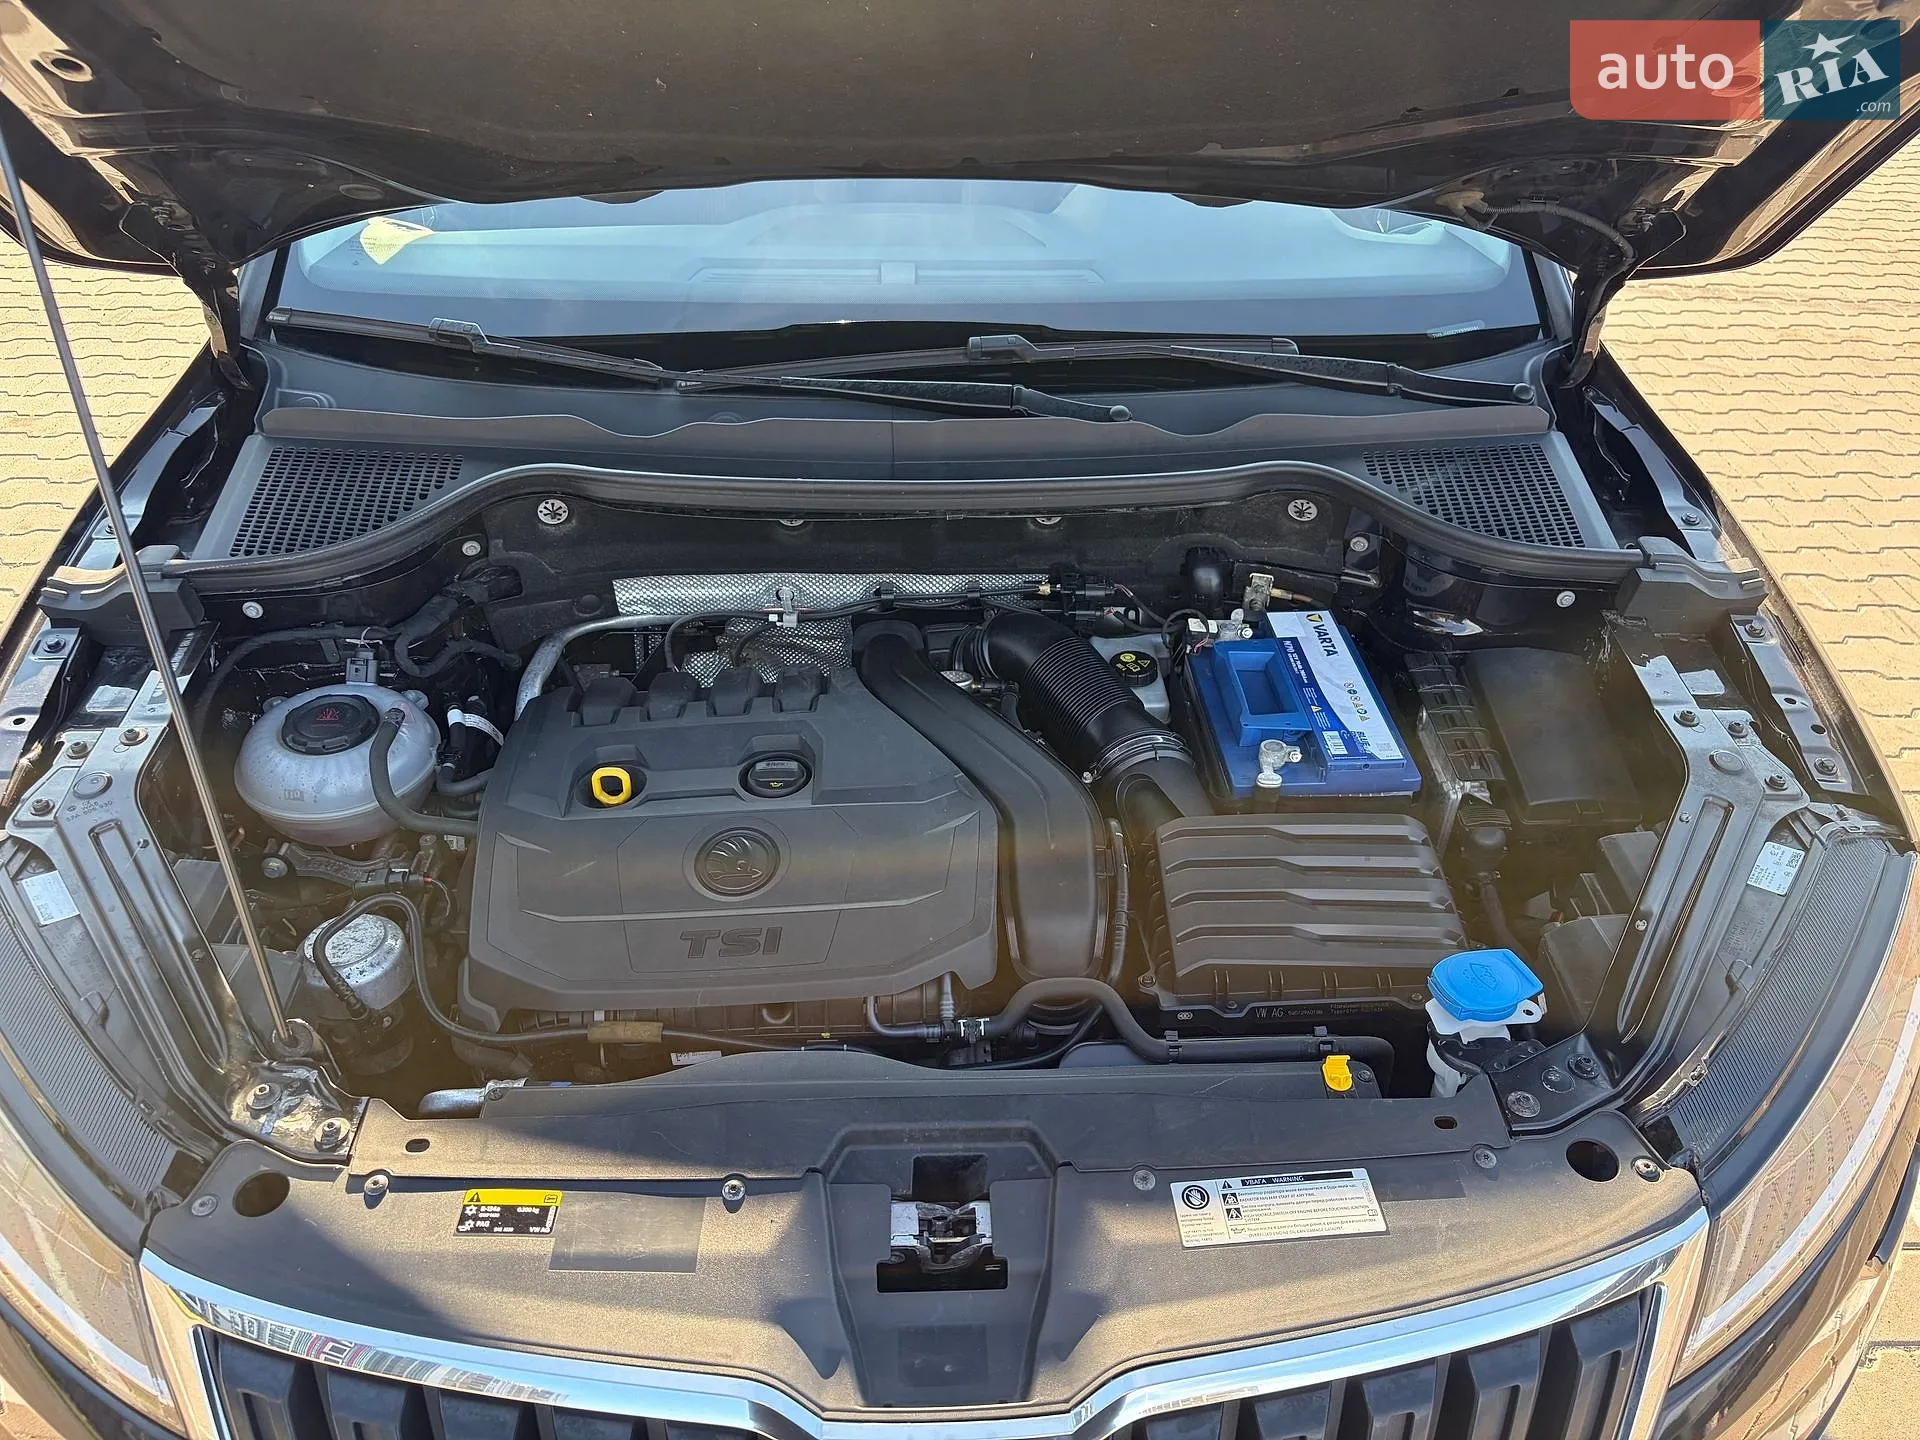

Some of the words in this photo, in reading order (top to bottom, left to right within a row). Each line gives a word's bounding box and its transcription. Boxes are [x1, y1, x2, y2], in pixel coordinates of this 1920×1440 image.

[1313, 624, 1339, 657] VARTA
[680, 927, 783, 959] TSI
[1244, 1178, 1267, 1186] УВАГА
[1271, 1175, 1304, 1183] WARNING
